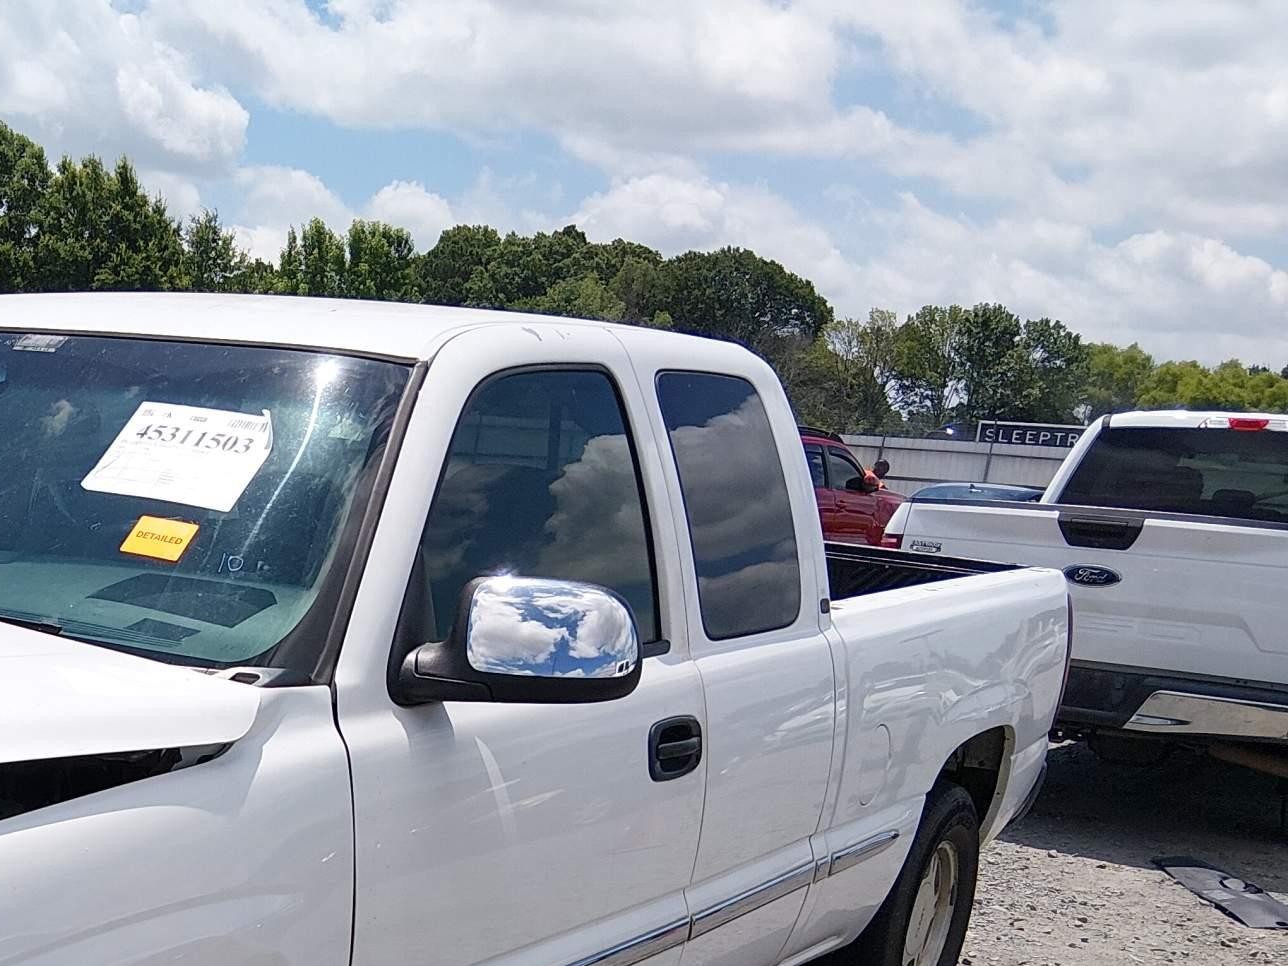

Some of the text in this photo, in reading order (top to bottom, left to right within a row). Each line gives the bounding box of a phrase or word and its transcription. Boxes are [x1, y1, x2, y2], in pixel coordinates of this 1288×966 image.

[136, 422, 255, 454] 45311503
[136, 530, 183, 546] DETAILED
[1074, 568, 1109, 583] Ford
